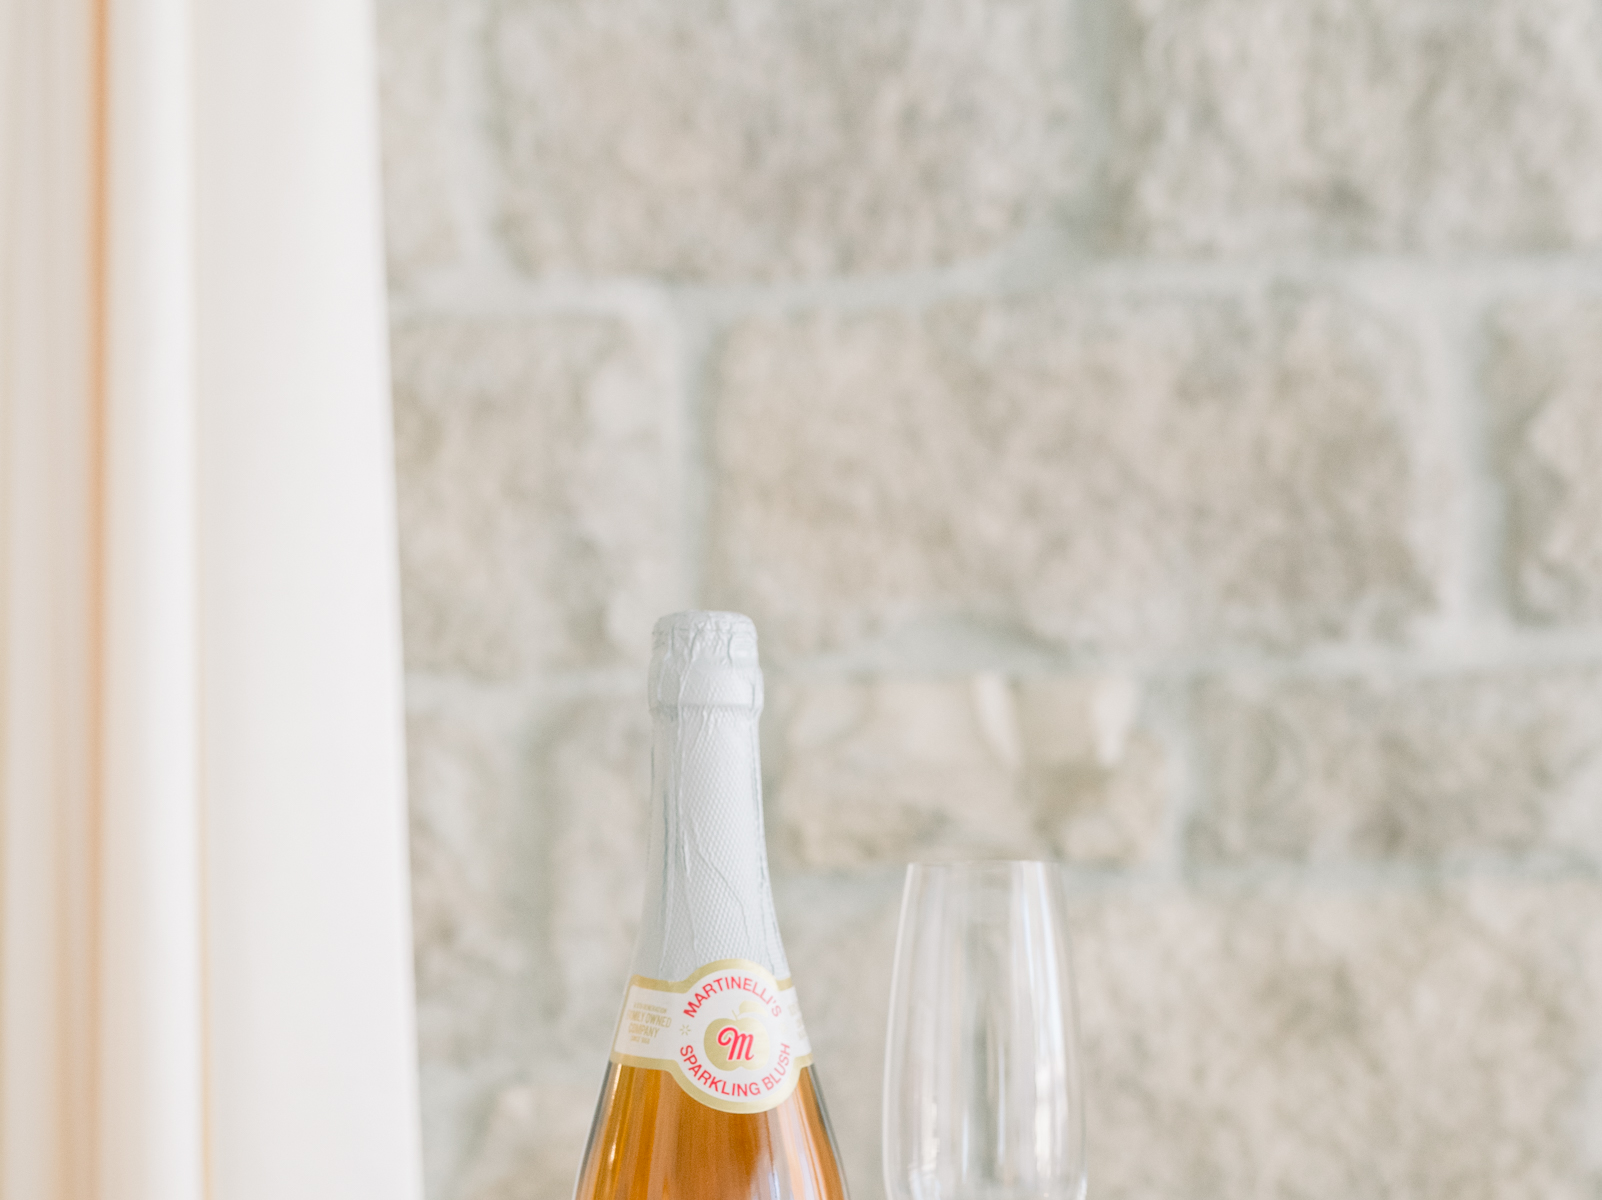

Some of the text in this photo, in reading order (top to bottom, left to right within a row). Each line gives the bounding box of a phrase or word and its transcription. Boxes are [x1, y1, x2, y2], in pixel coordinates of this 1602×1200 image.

[683, 976, 782, 1018] MARTINELLI'S
[680, 1042, 791, 1097] SPARKLING BLUSH
